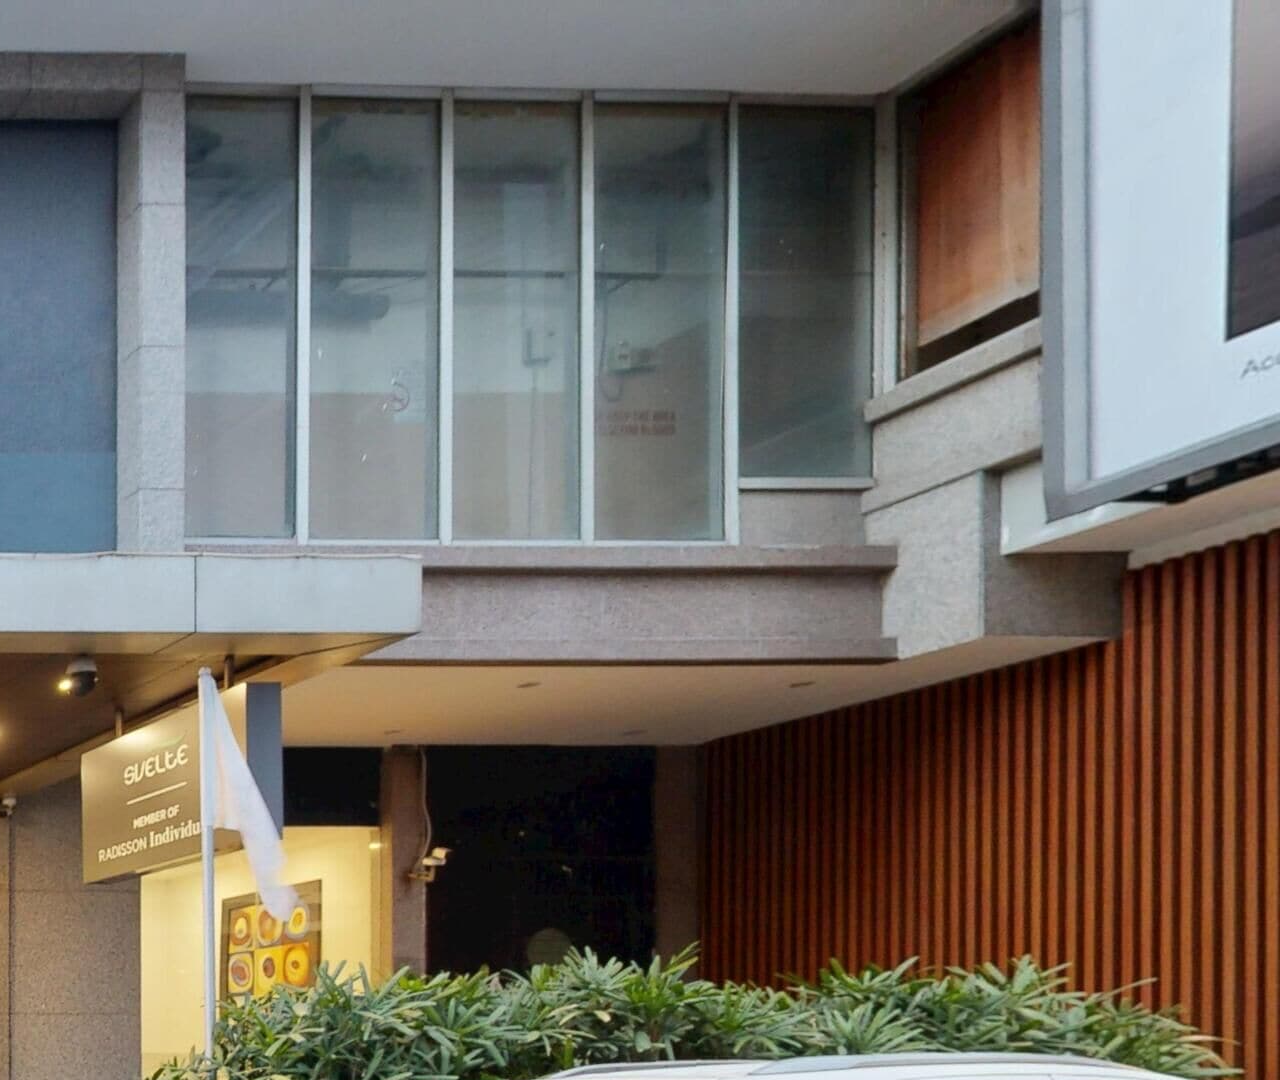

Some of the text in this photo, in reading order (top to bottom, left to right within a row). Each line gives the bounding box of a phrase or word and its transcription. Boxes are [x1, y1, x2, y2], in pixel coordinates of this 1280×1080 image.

[123, 744, 188, 785] SVELTE
[133, 804, 180, 829] MEMBER OF
[97, 819, 201, 863] RADISSON Individu
